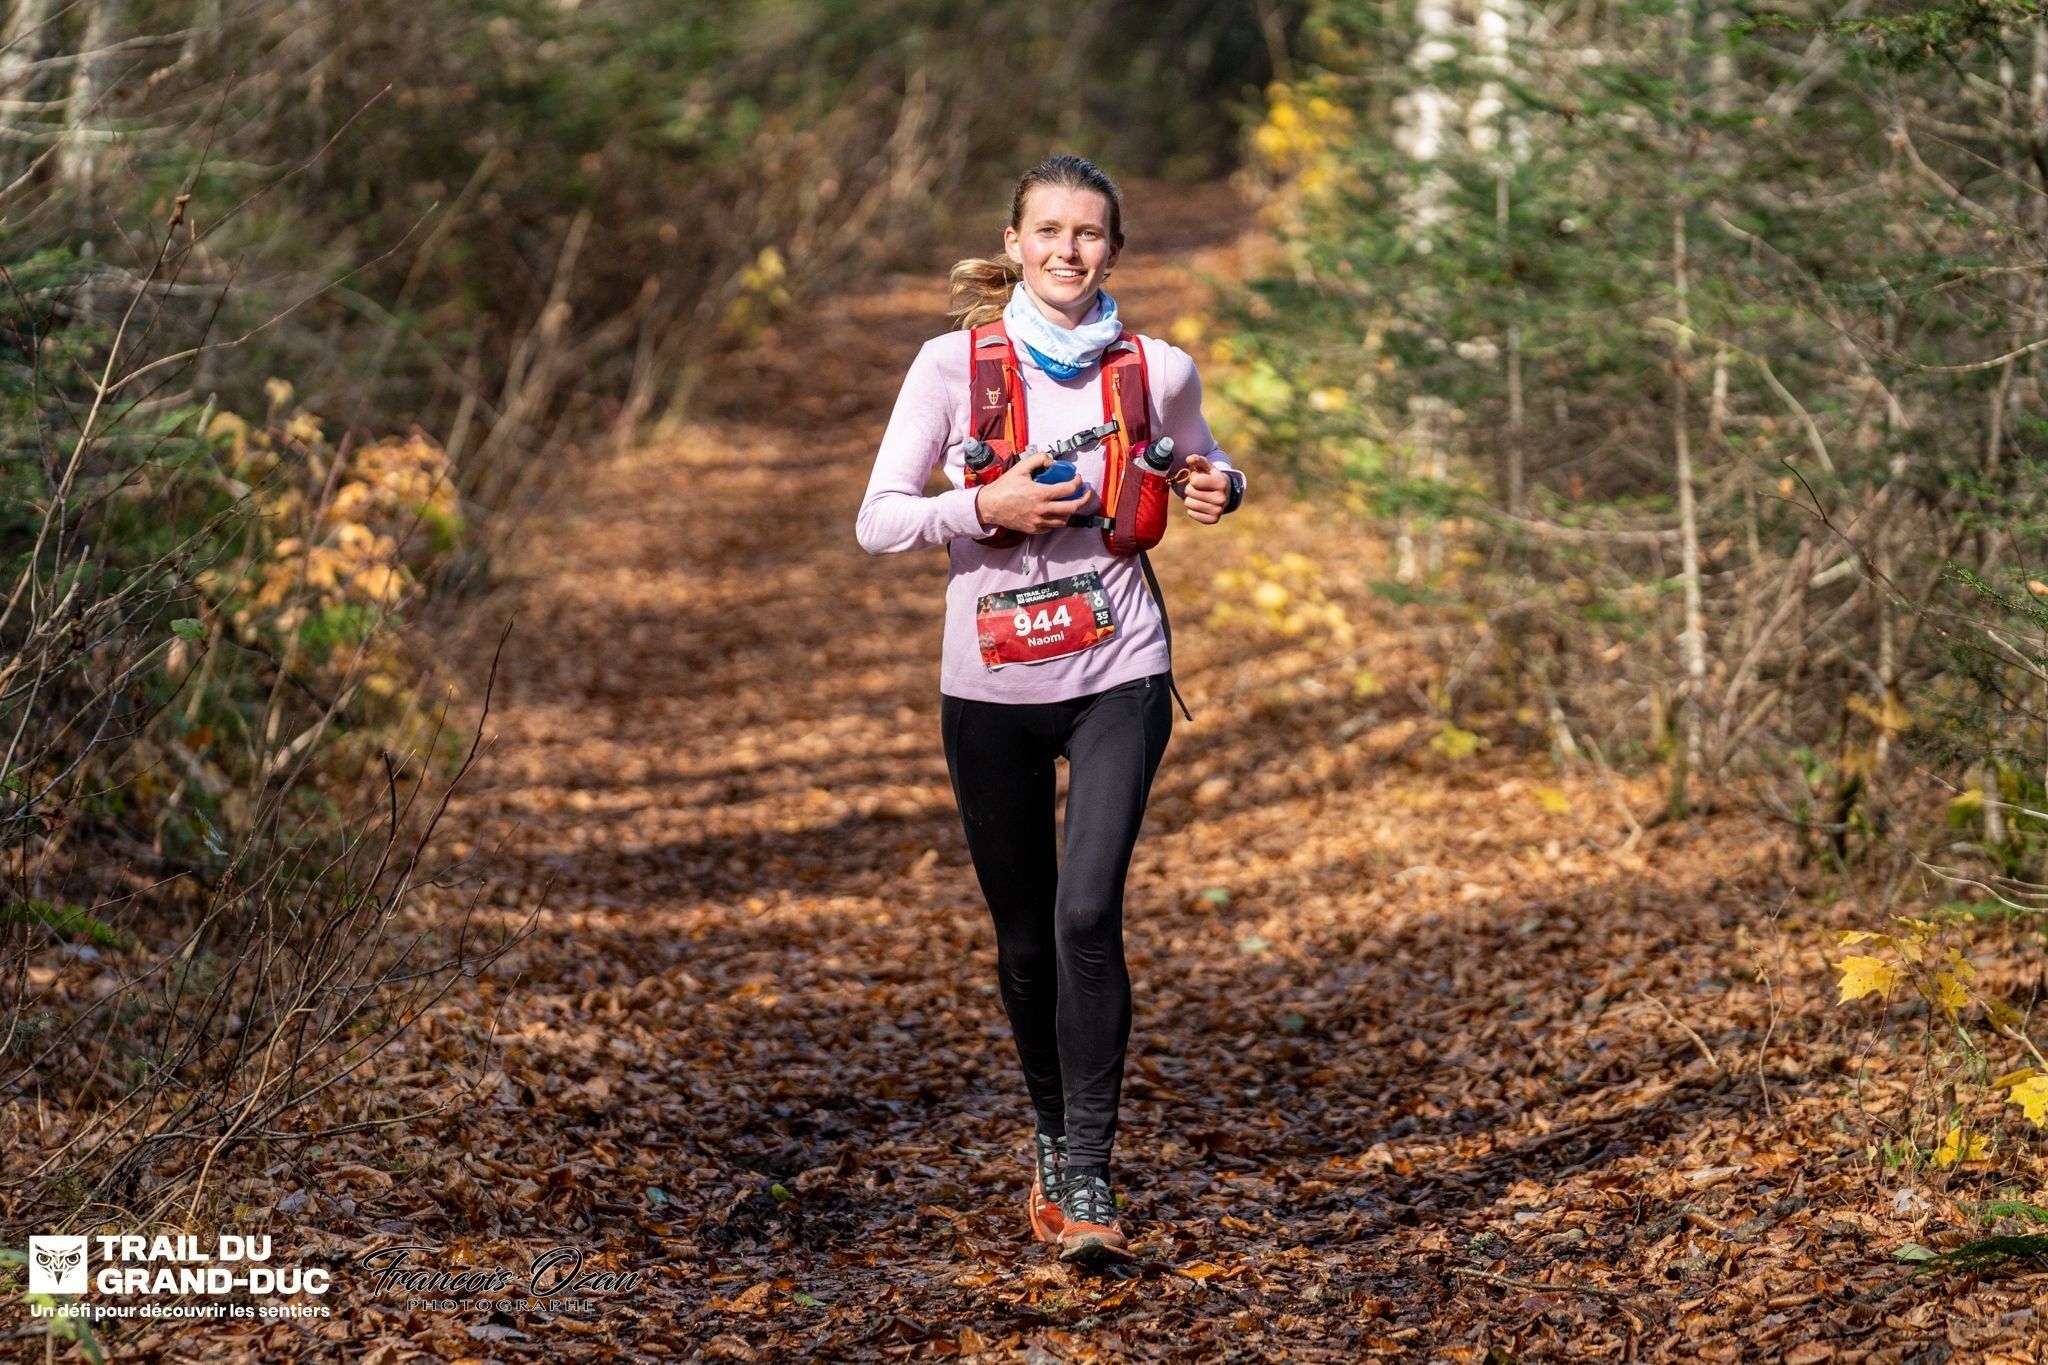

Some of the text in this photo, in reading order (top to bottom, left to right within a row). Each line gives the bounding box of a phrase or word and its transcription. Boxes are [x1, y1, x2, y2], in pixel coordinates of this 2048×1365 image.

[1023, 590, 1040, 598] TRAIL
[1025, 591, 1059, 602] GRAND-DUC
[1013, 605, 1072, 636] 944
[1096, 611, 1109, 621] 35
[1027, 631, 1065, 647] Naomi
